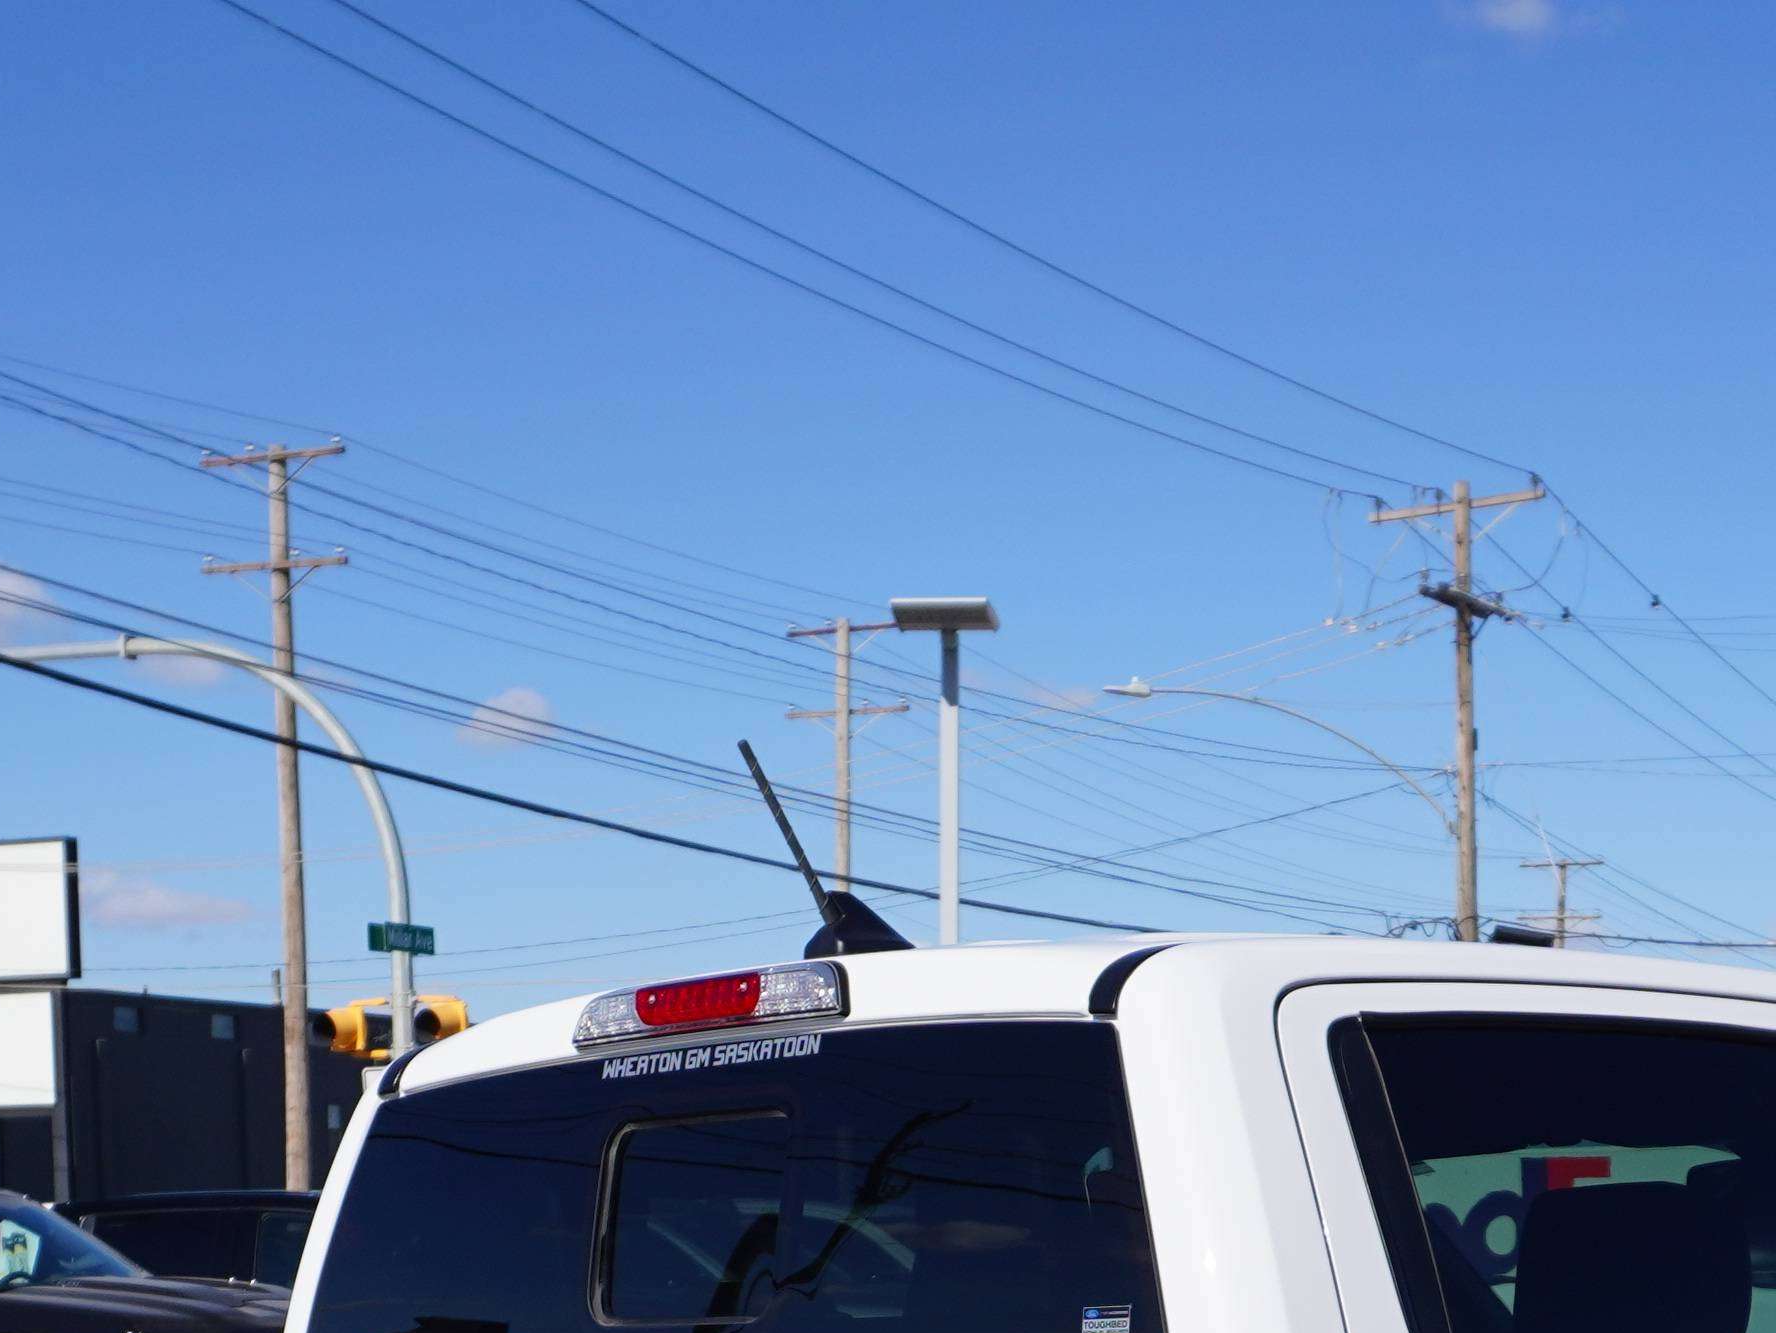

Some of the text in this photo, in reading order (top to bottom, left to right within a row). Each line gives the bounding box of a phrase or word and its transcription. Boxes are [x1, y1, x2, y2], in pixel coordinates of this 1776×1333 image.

[601, 1032, 822, 1080] WHEATON GM SASKATOON
[1083, 1320, 1128, 1330] TOUGHBED
